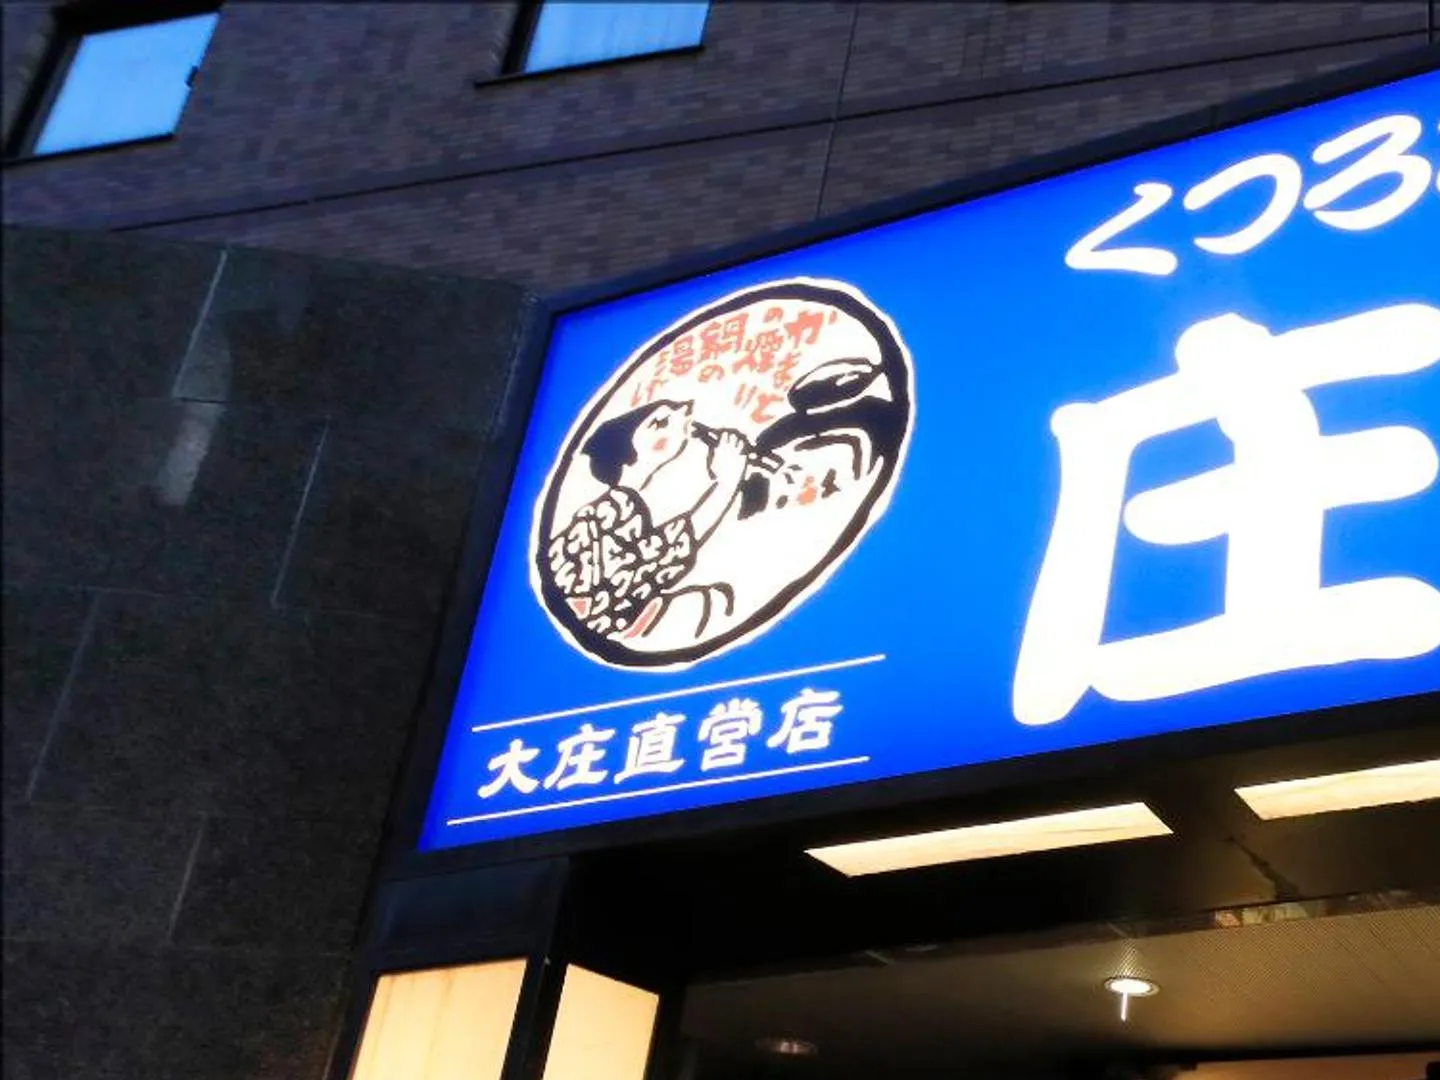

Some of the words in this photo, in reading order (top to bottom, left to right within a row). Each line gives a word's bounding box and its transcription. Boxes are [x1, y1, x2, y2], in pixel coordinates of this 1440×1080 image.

[477, 687, 843, 798] 大庄直営店
